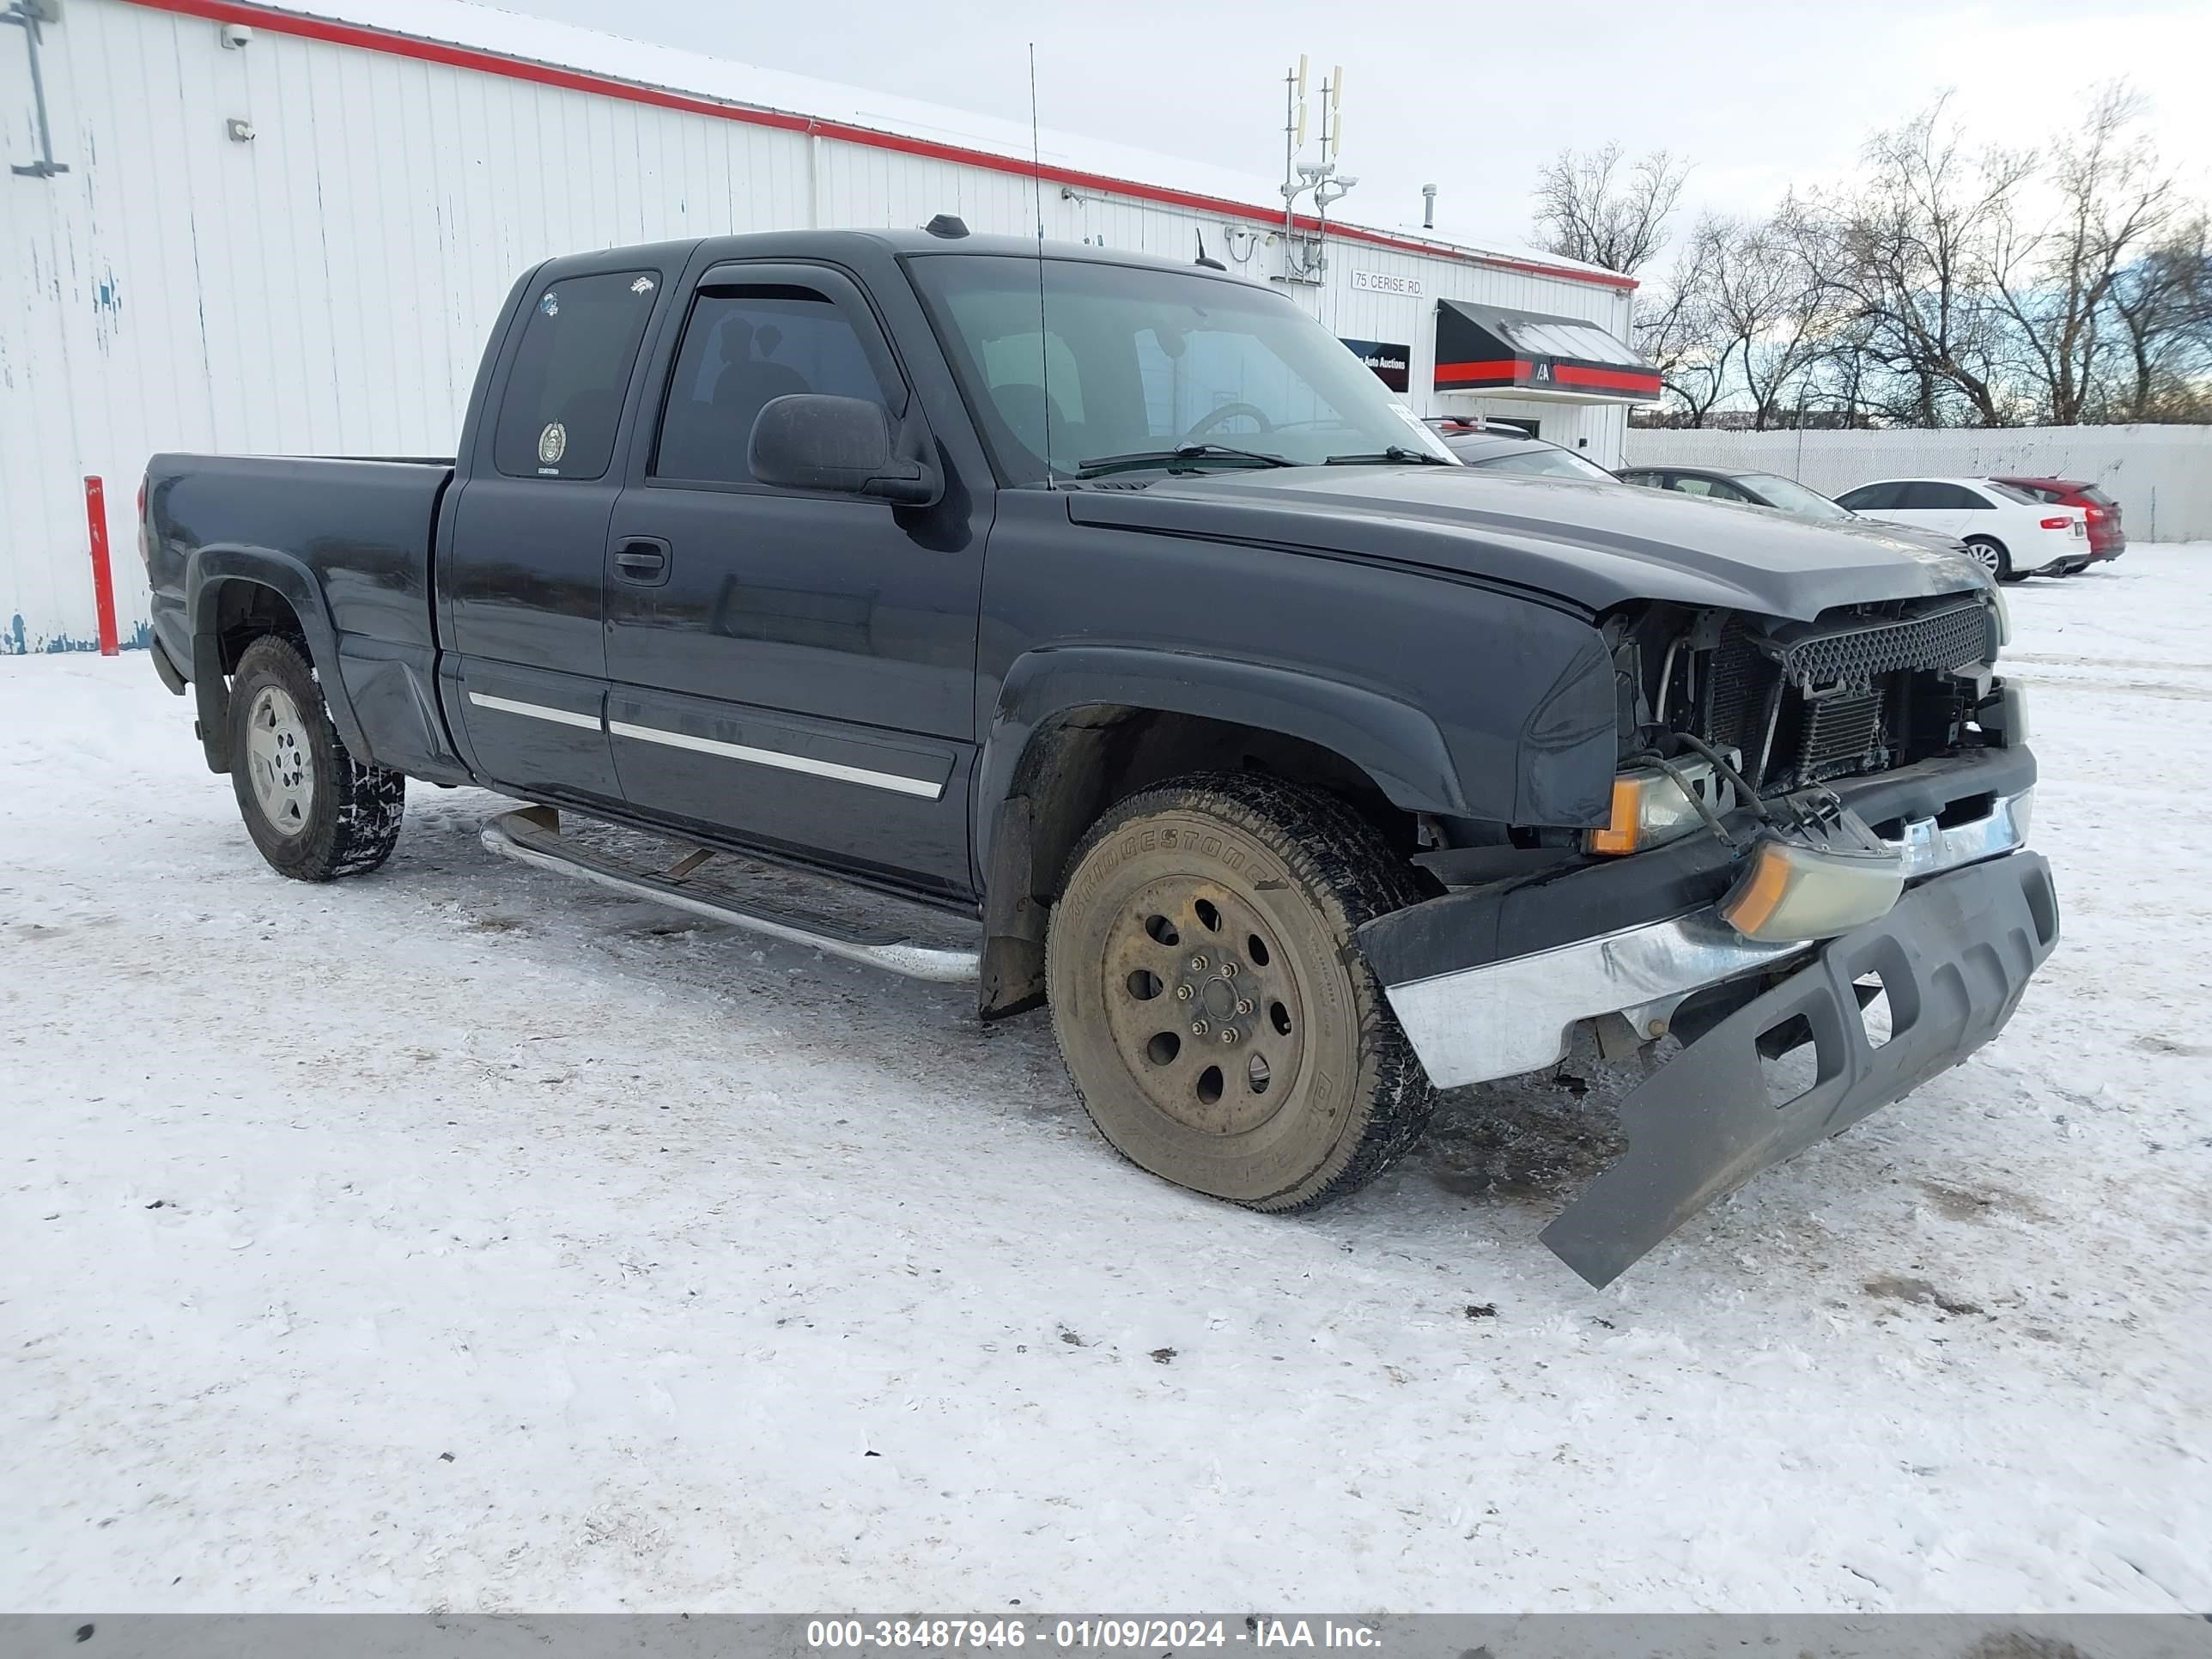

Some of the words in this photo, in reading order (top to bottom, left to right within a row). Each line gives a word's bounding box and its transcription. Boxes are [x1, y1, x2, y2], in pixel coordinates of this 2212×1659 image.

[1355, 272, 1367, 287] 75
[1370, 275, 1405, 292] CERISE
[1407, 280, 1423, 295] RD.
[1364, 355, 1379, 368] Auto
[1379, 356, 1406, 369] Auctions
[1068, 829, 1268, 926] BRIDGESTONE
